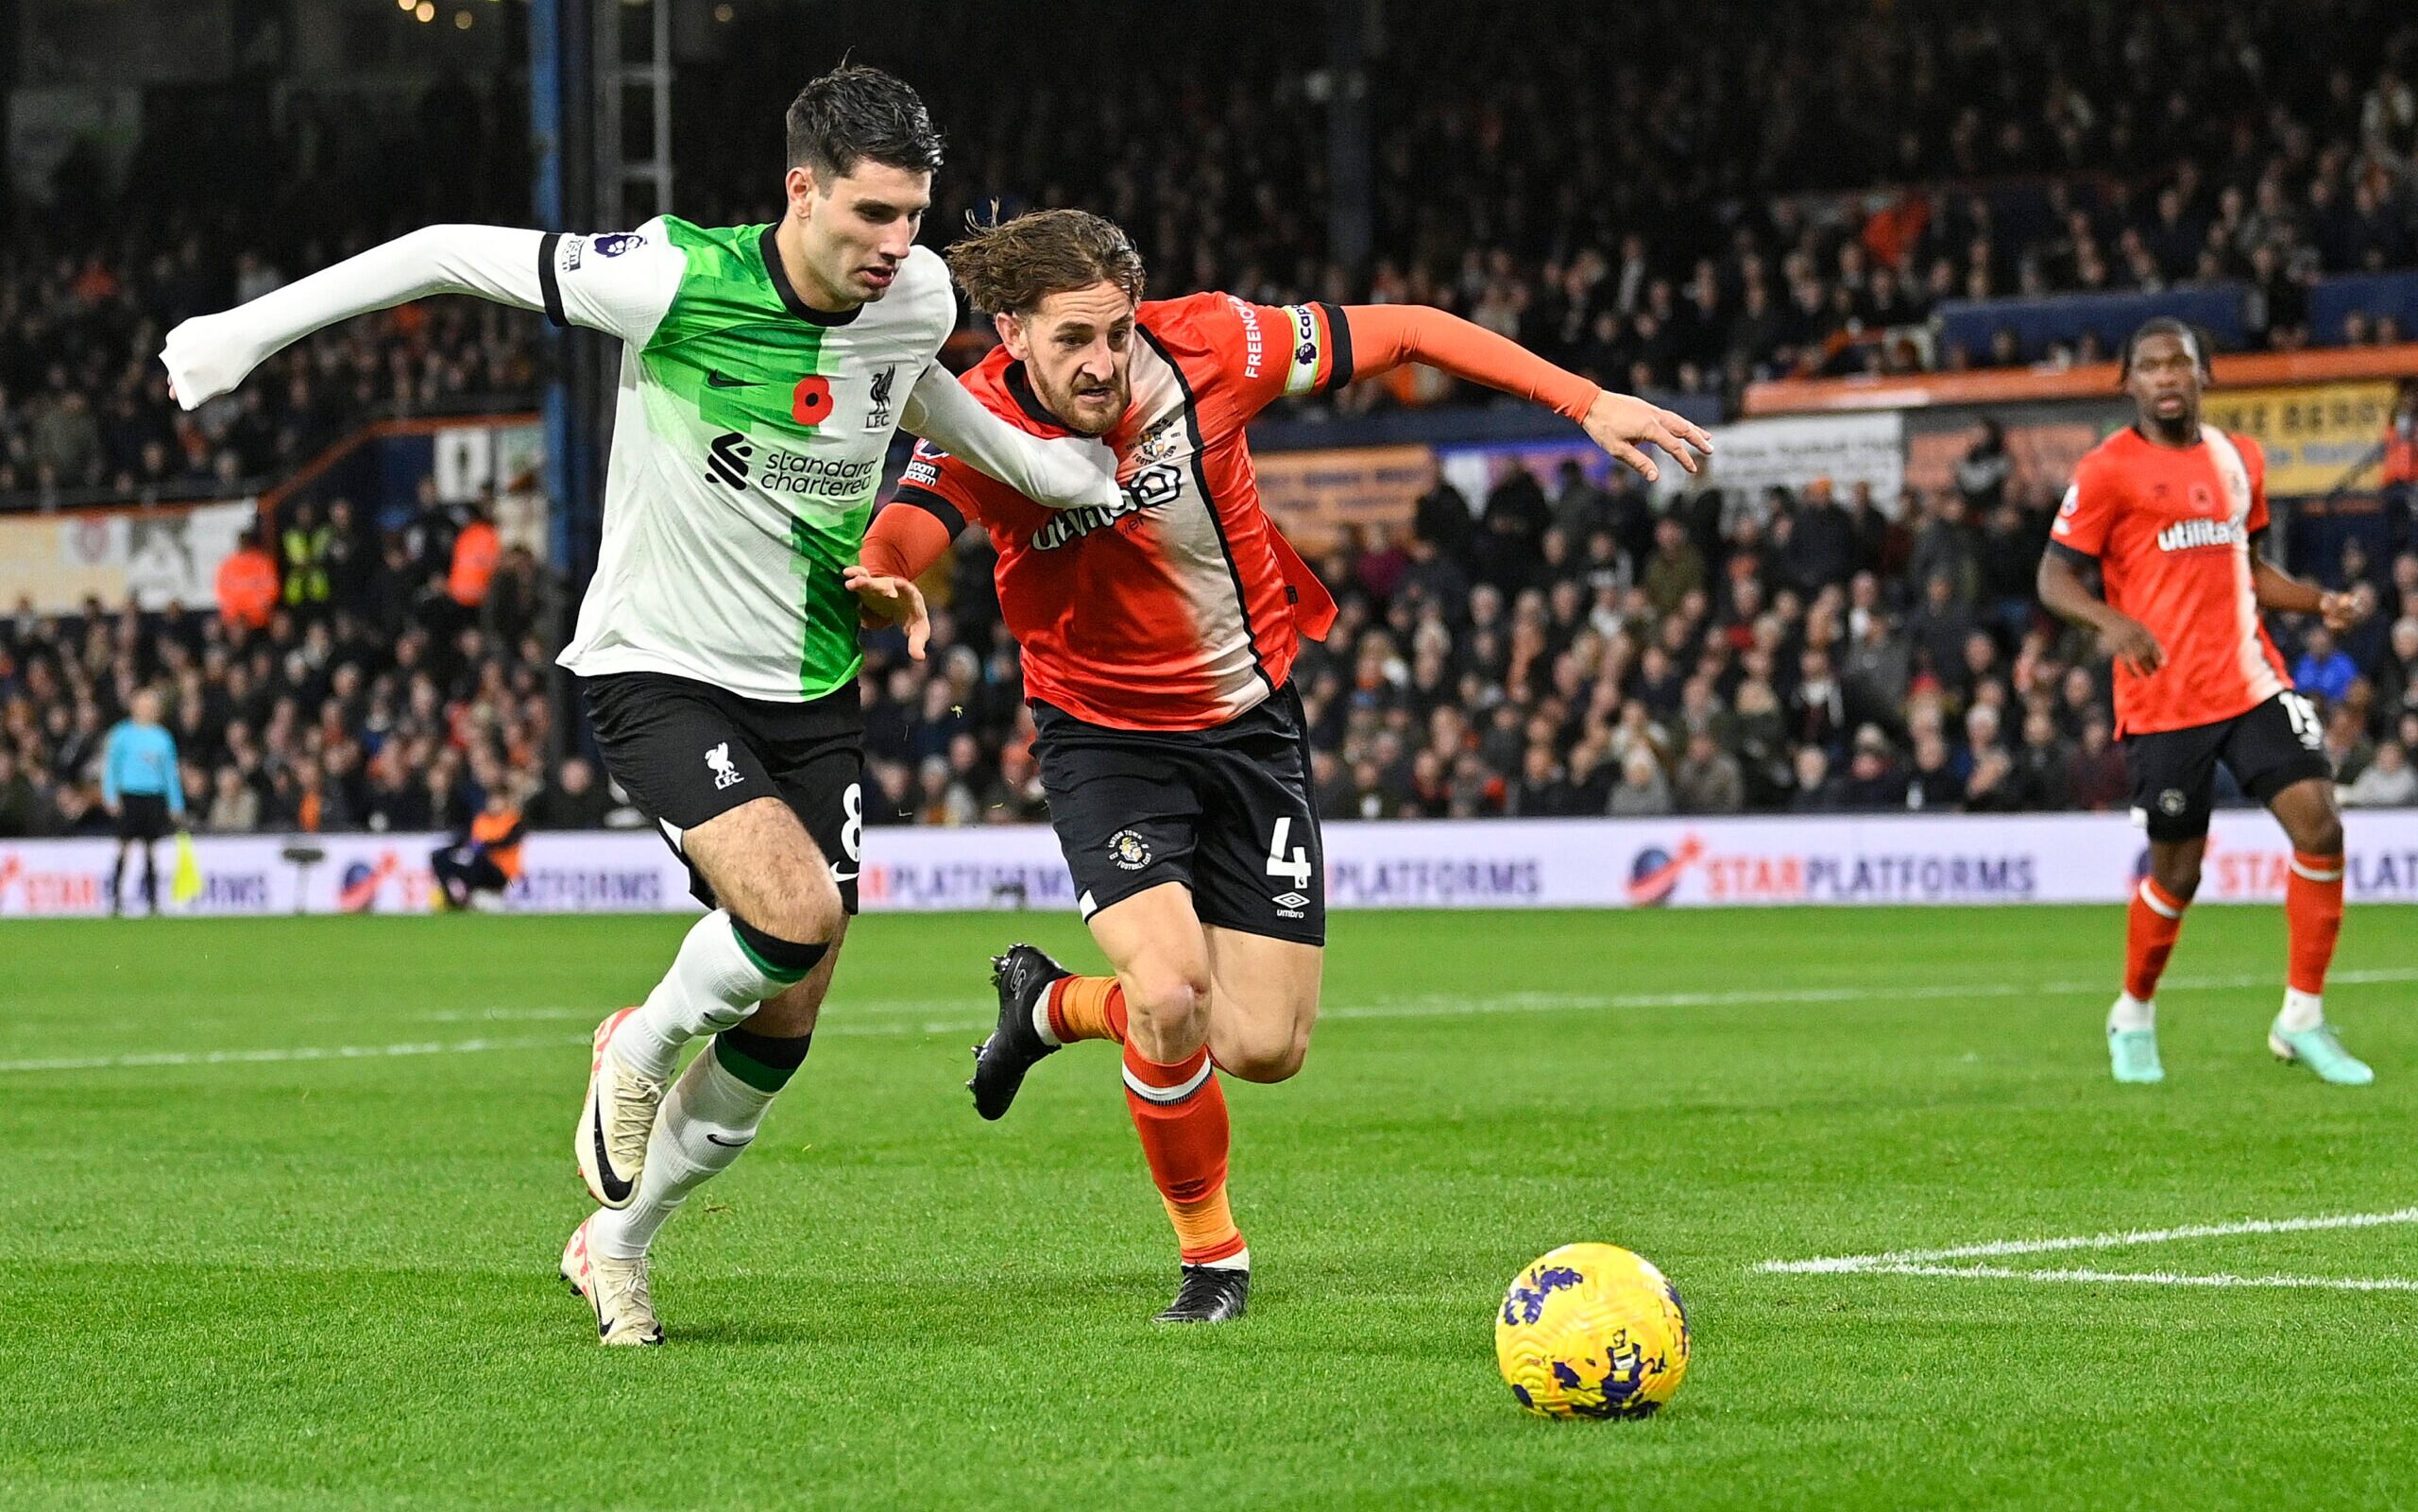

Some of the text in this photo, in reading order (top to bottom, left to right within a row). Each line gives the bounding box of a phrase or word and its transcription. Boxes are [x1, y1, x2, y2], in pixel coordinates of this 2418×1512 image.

[766, 450, 878, 478] standard
[760, 469, 872, 497] chartered
[841, 783, 861, 862] 8
[1267, 817, 1312, 889] 4
[1276, 909, 1304, 919] umbro
